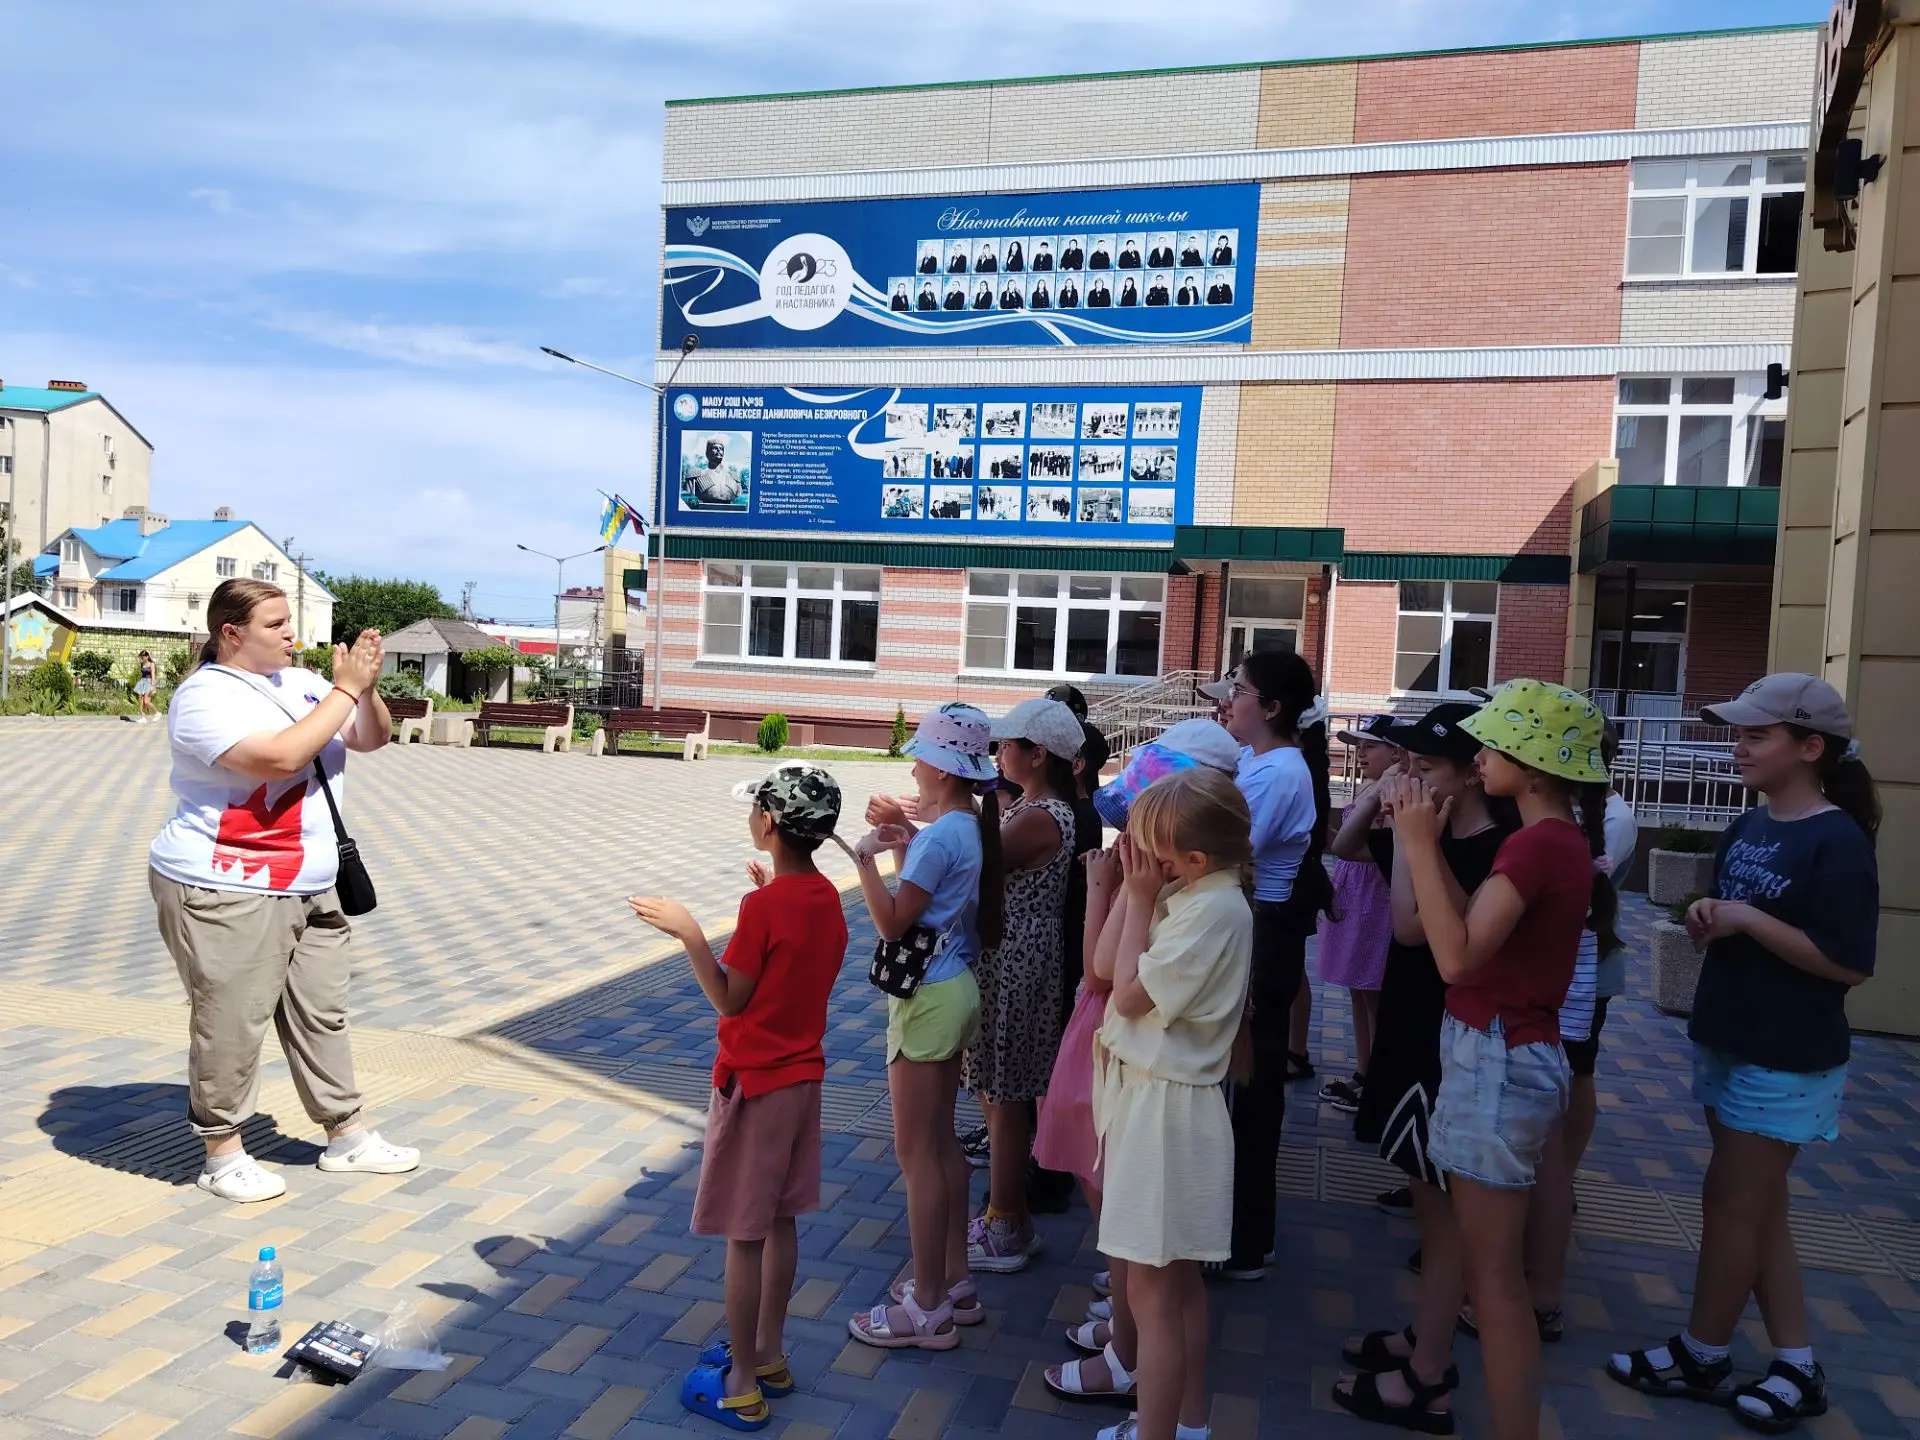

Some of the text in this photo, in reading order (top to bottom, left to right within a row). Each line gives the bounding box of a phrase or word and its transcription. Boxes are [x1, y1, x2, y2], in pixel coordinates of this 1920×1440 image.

[936, 206, 1189, 231] Наставники нашей школы
[776, 284, 835, 296] ГОД ПЕДАГОГА
[776, 298, 835, 308] И НАСТАВНИКА
[702, 396, 764, 407] МАОУ СОШ №35
[701, 408, 868, 421] ИМЕНИ АЛЕКСЕЯ ДАНИЛОВИЧА БЕЗКРОВНОГО
[1729, 860, 1792, 899] energy
